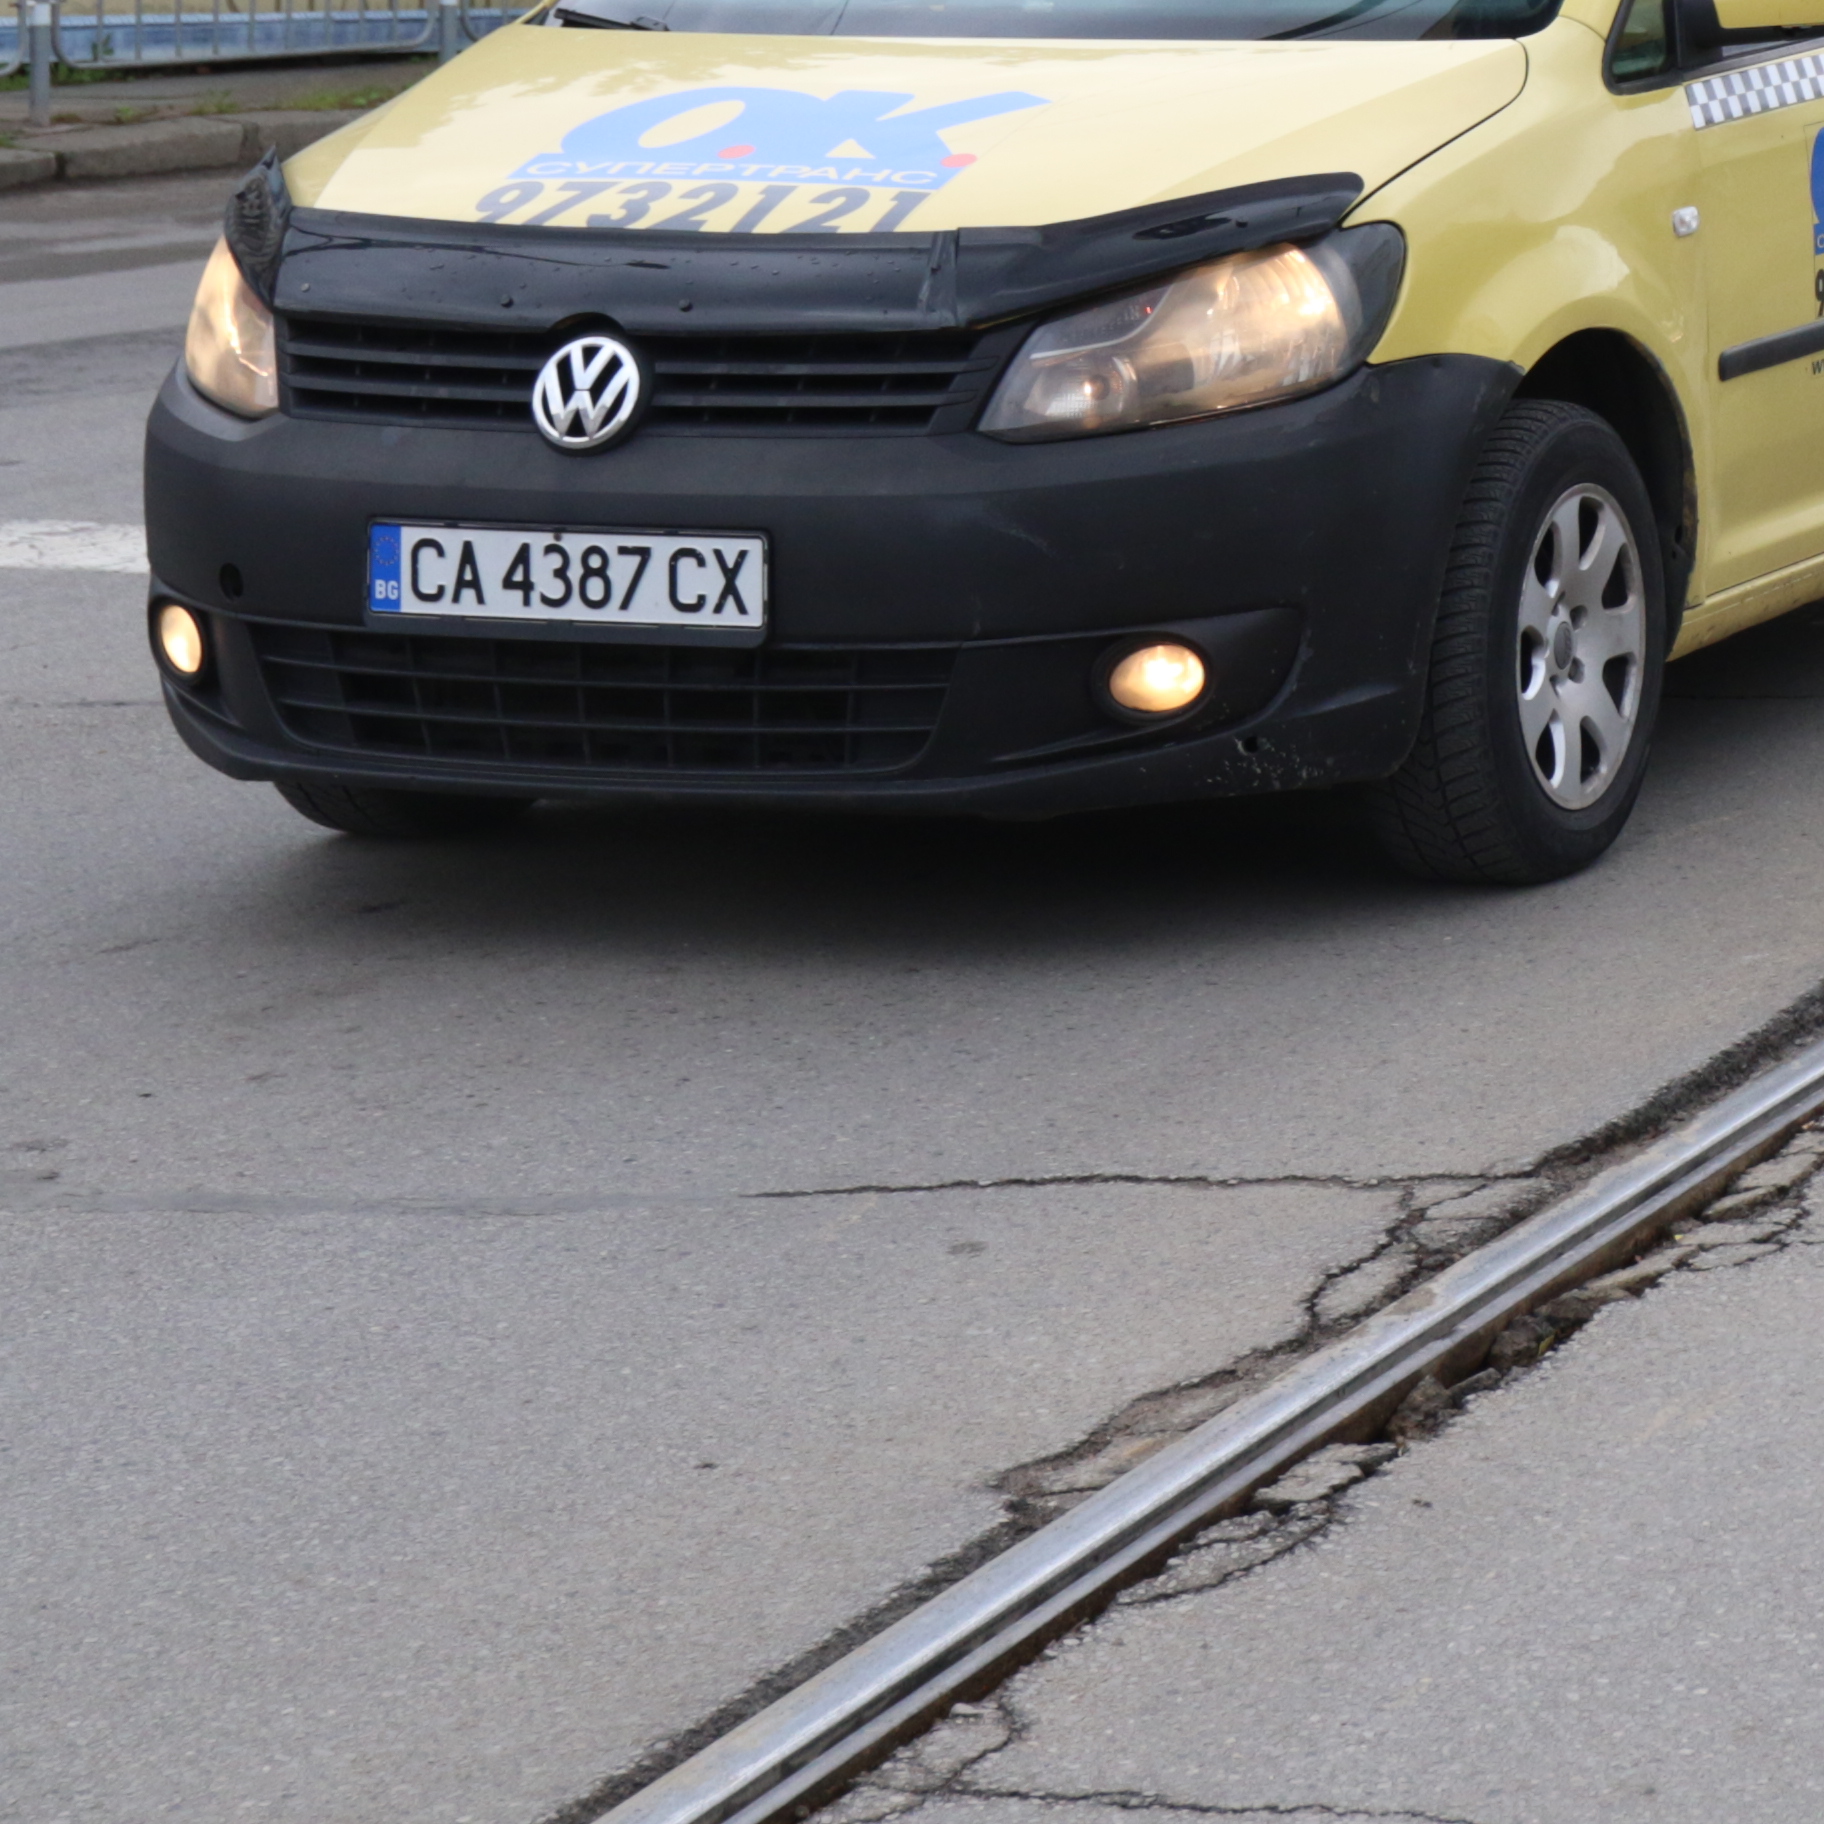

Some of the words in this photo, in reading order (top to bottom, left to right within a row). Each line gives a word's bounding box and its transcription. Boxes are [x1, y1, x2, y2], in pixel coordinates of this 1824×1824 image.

[526, 161, 940, 186] СУПЕРТРАНС
[474, 180, 932, 233] 9732121
[375, 579, 398, 601] BG
[502, 543, 652, 610] 4387
